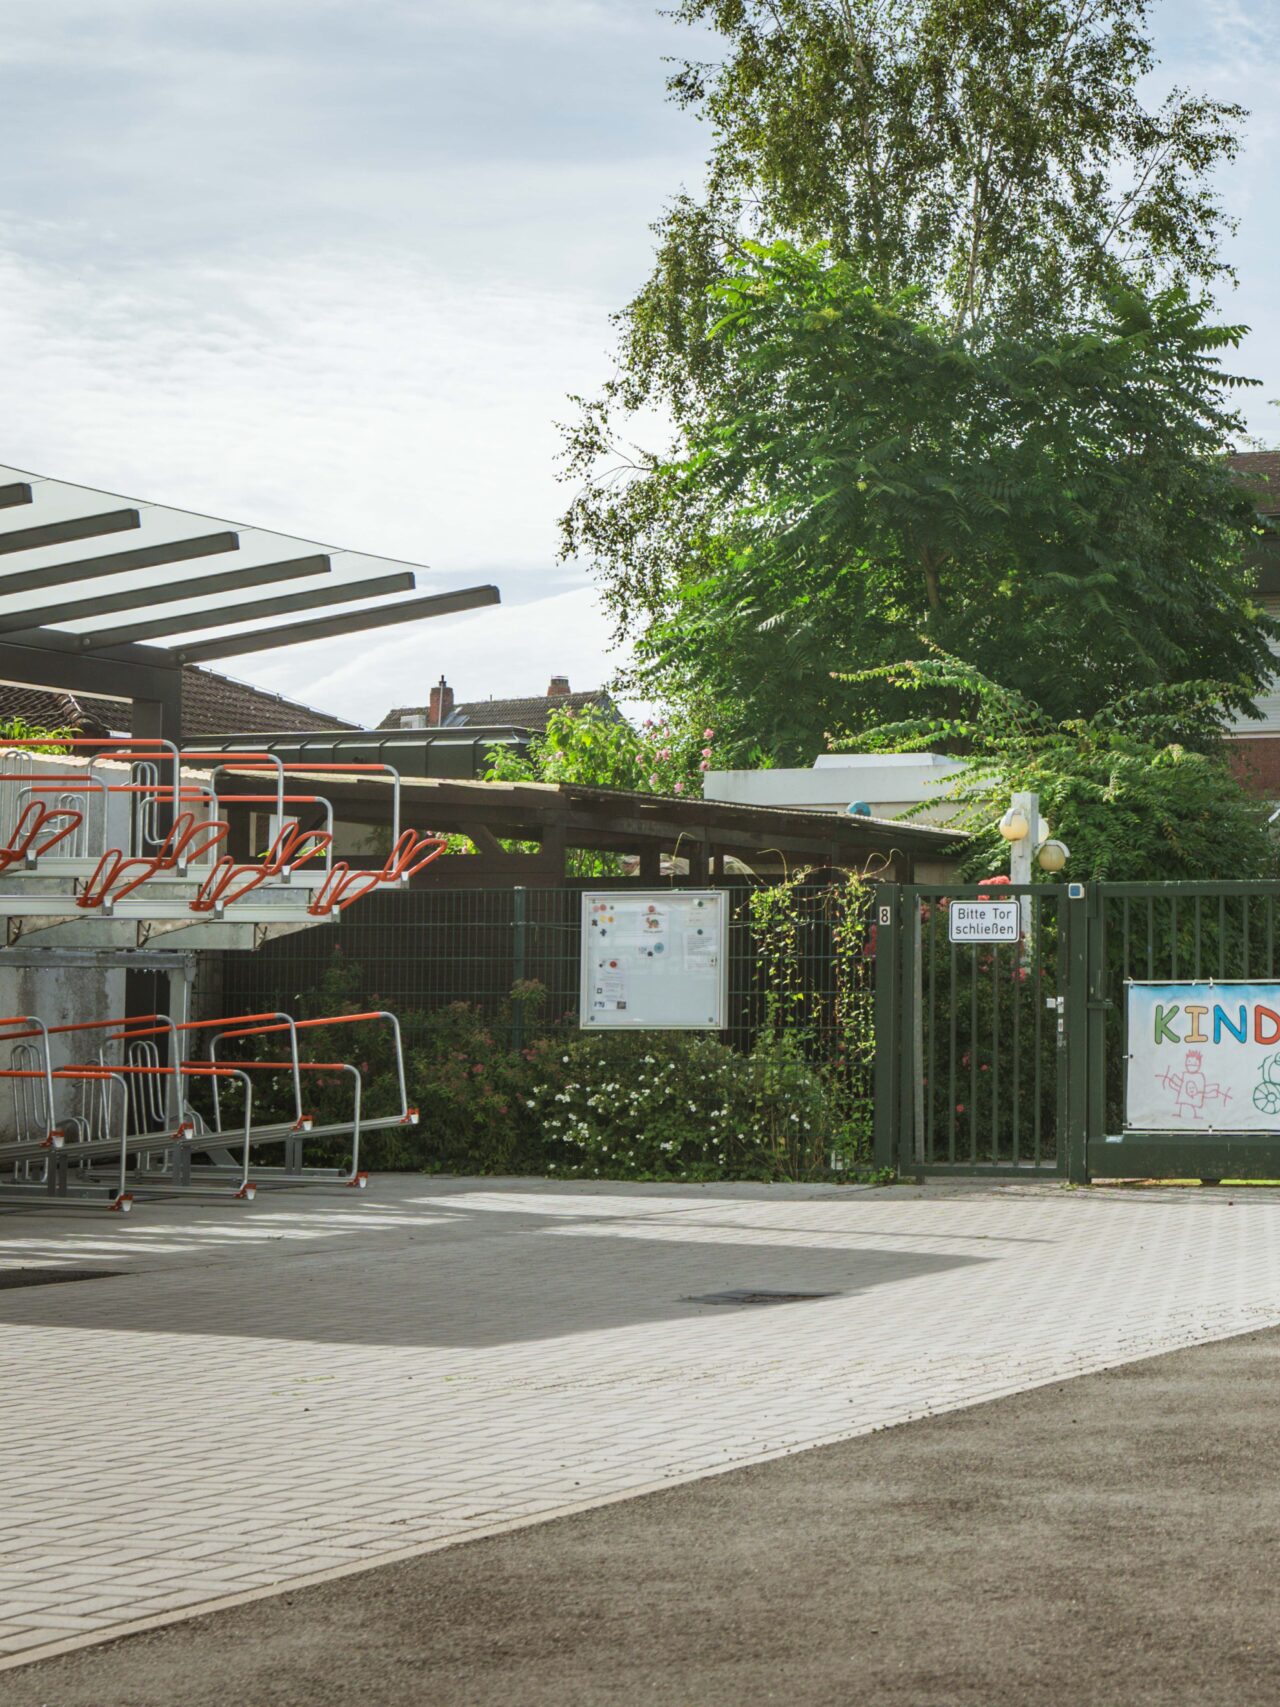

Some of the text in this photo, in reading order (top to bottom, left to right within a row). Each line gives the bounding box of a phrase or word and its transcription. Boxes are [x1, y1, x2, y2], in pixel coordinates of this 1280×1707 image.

[881, 908, 889, 924] 8
[958, 908, 1012, 920] Bitte Tor
[955, 922, 1014, 935] schließen
